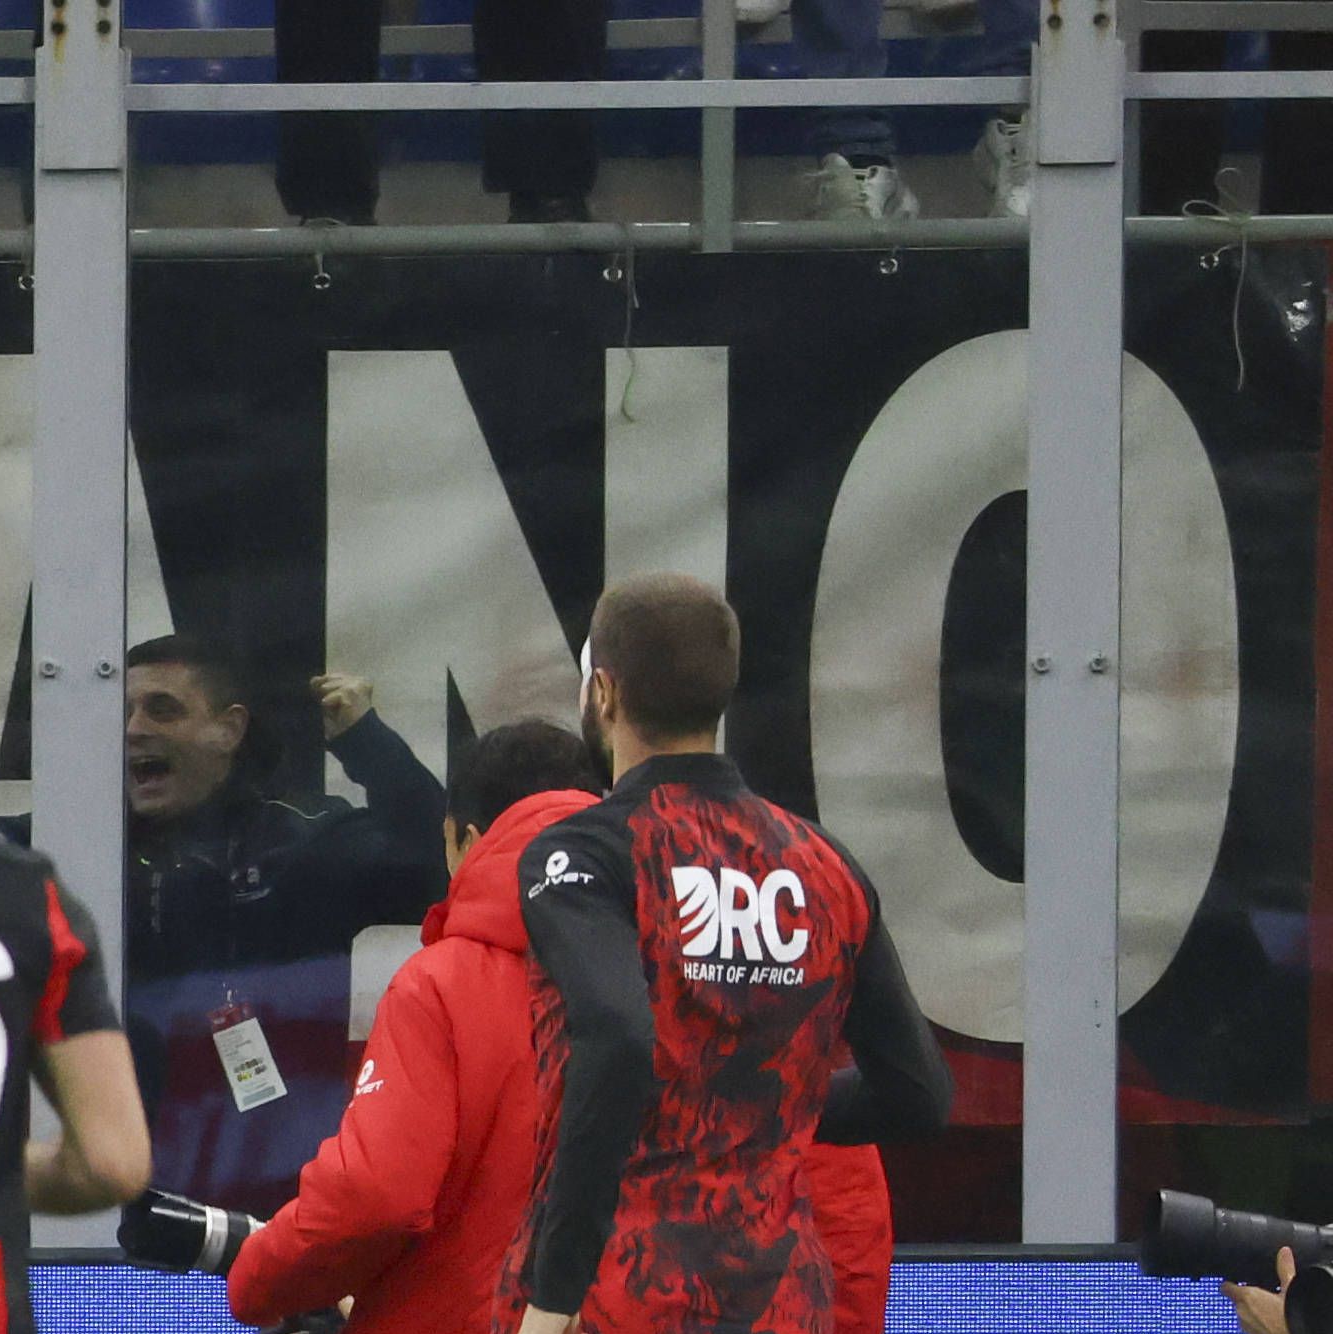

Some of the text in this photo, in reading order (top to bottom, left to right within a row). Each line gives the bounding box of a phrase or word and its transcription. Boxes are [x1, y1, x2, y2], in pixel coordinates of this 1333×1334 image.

[670, 866, 809, 963] DRC
[684, 963, 805, 986] HEART OF AFRICA
